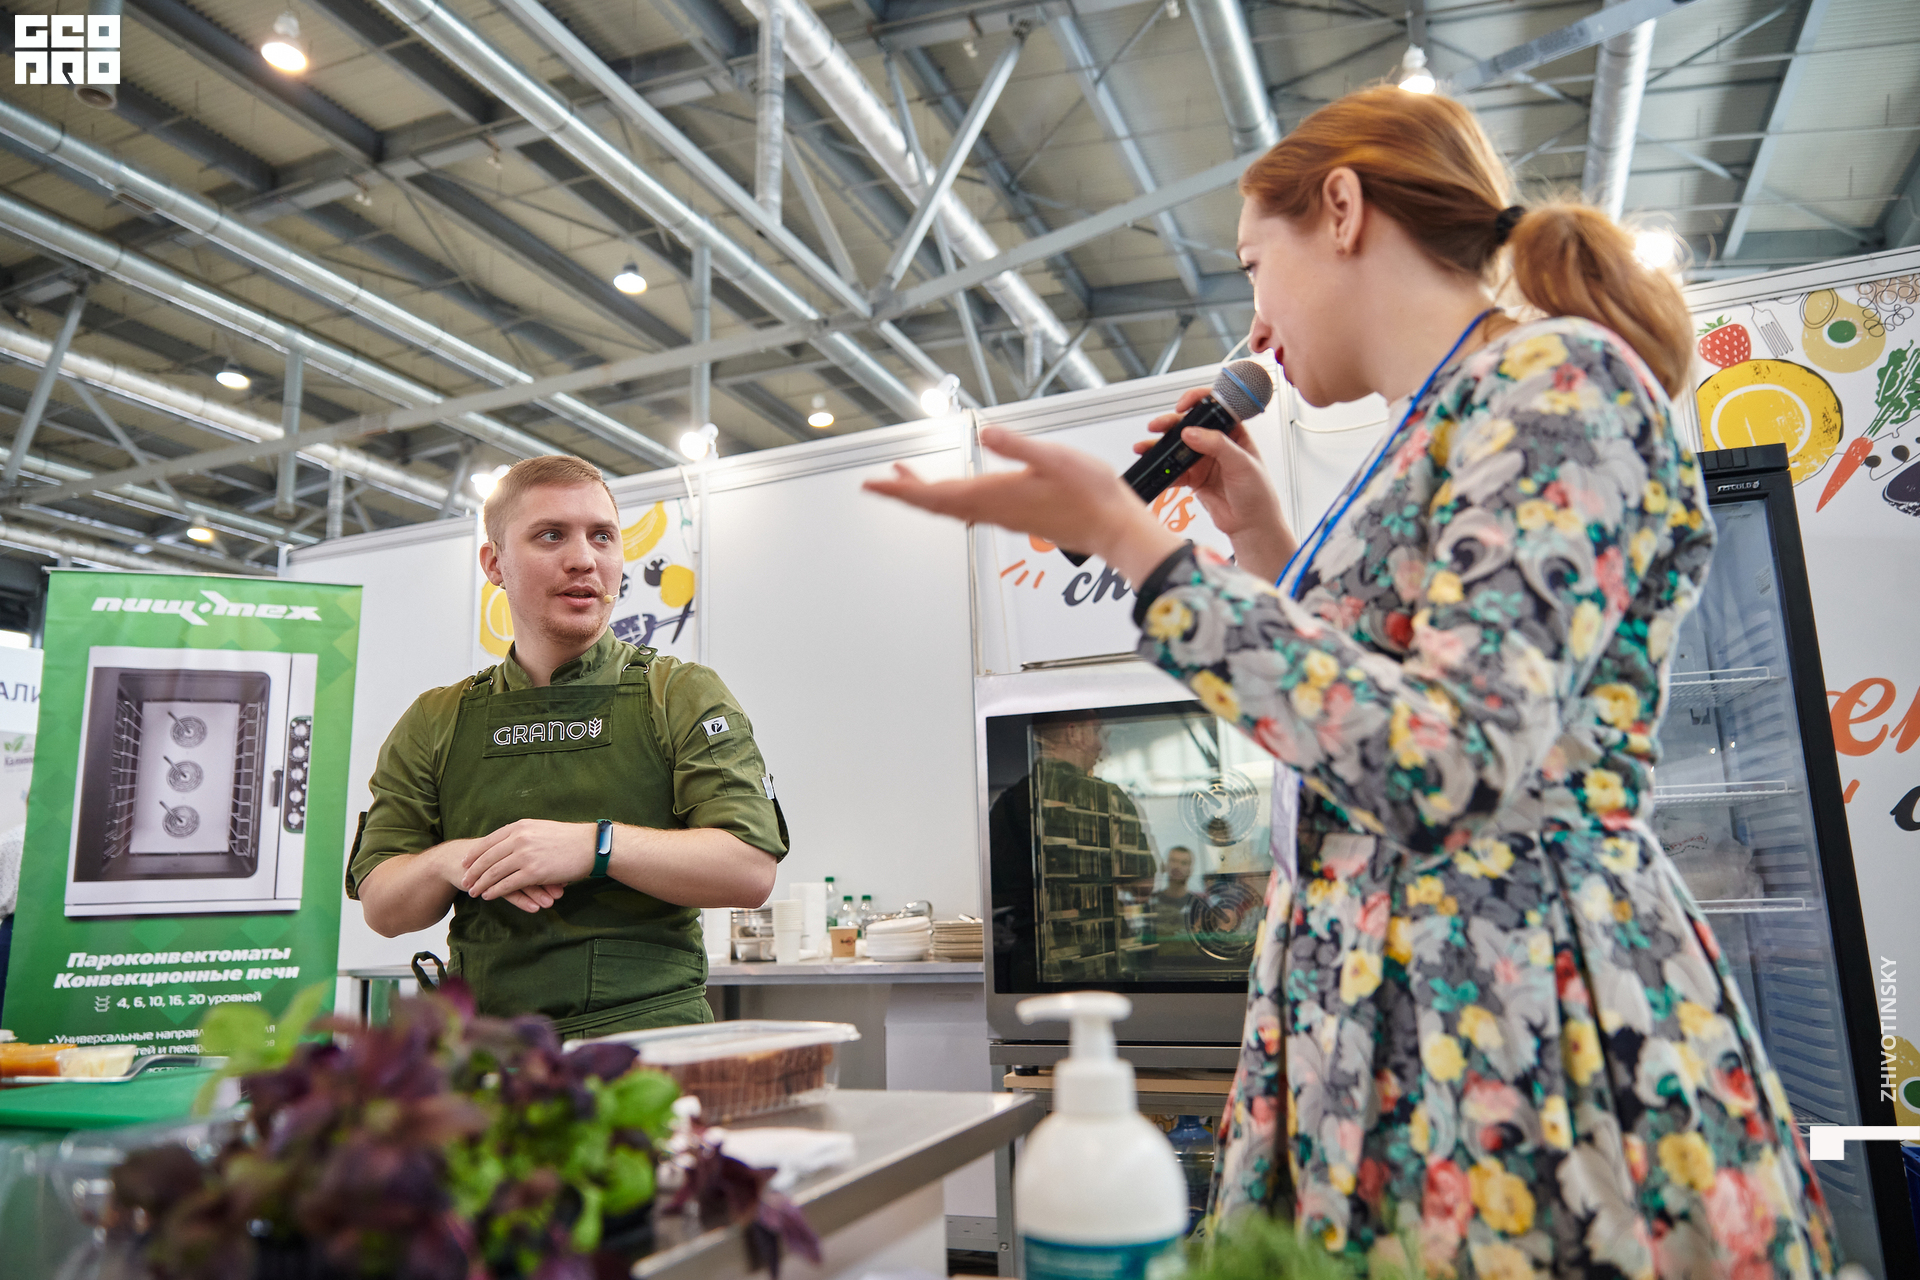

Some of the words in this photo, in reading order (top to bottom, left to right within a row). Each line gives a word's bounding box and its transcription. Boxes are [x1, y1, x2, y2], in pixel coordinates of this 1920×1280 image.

[493, 721, 587, 746] GRANO
[66, 947, 292, 971] Пароконвектоматы
[53, 968, 243, 989] Конвекционные
[245, 966, 300, 981] печи
[116, 997, 130, 1009] 4,
[133, 996, 146, 1008] 6,
[149, 995, 166, 1007] 10,
[187, 993, 206, 1005] 20
[206, 991, 262, 1006] уровней
[55, 1031, 153, 1045] Универсальные
